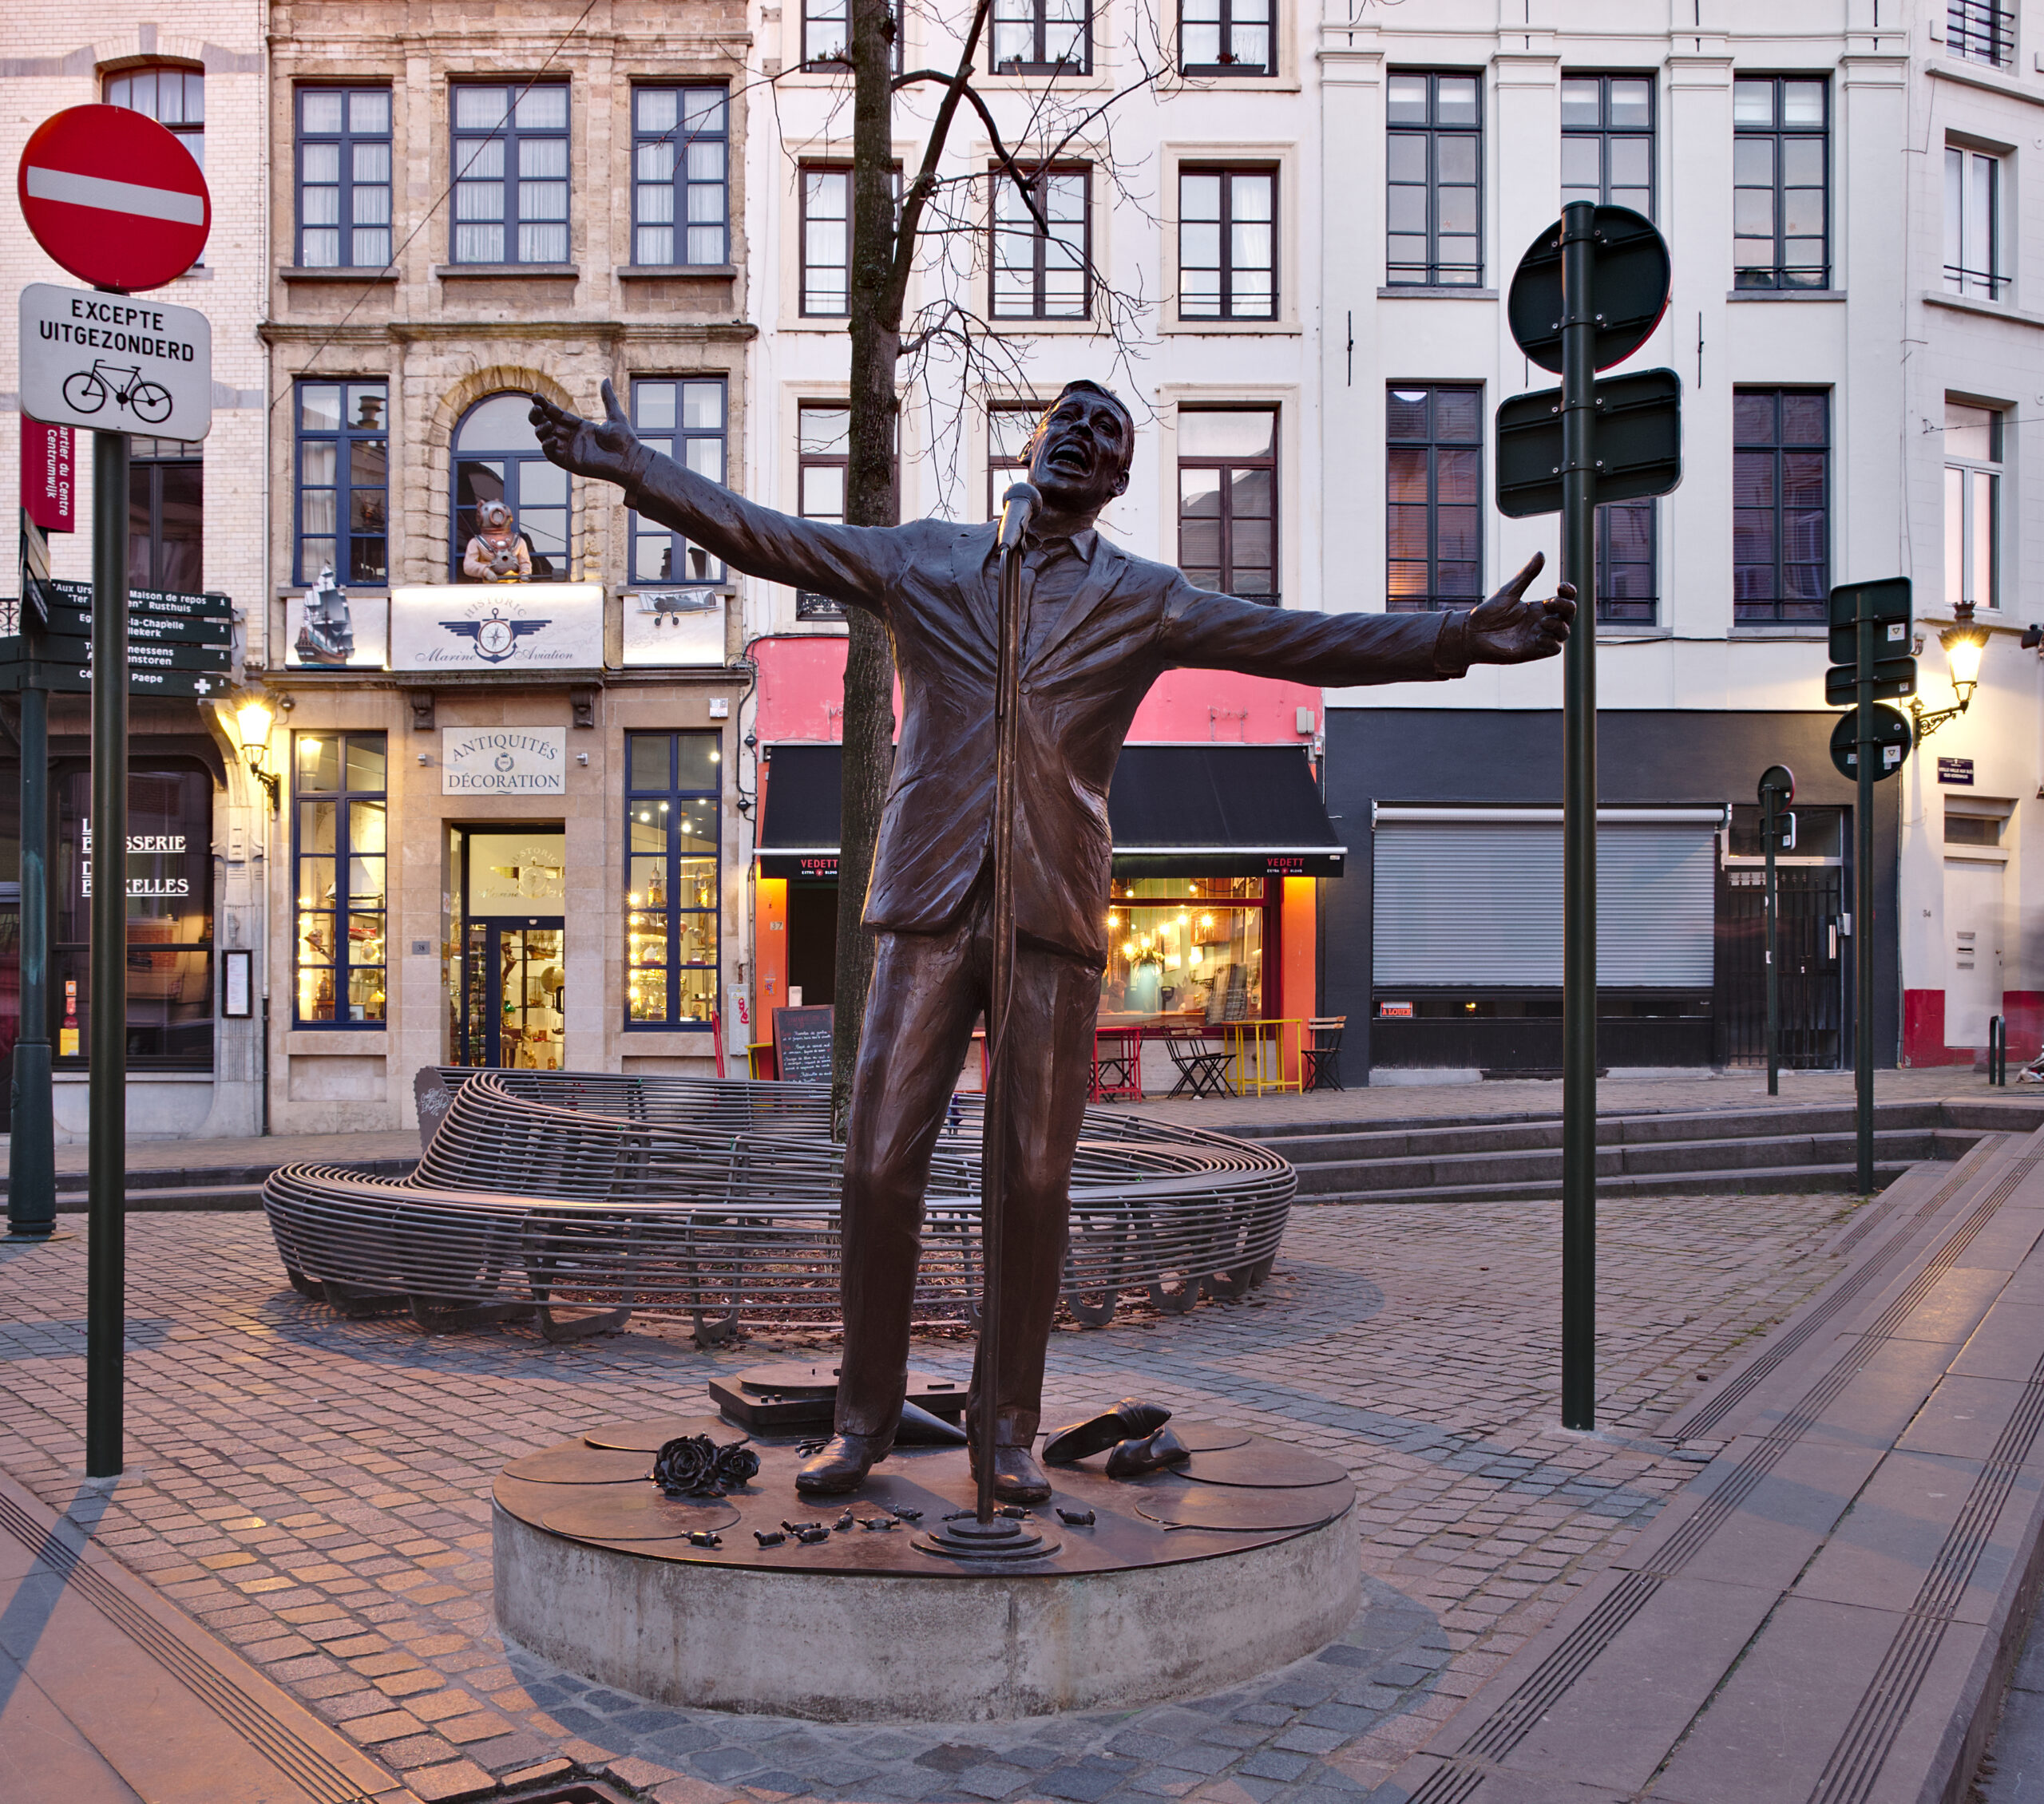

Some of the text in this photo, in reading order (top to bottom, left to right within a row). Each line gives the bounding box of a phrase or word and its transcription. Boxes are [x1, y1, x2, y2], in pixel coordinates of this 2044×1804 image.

[72, 299, 164, 331] EXCEPTE
[39, 320, 194, 362] UITGEZONDERD
[46, 429, 57, 499] Centrumwijk
[58, 425, 70, 516] artier du Centre
[129, 590, 162, 601] Maison
[180, 595, 207, 605] repos
[149, 601, 192, 613] Rusthuis
[464, 596, 527, 619] HISTORIC
[127, 617, 184, 630] -la-Chapelle
[128, 645, 174, 657] neessens
[414, 646, 573, 662] Marine Aviation
[132, 673, 164, 684] Paepe
[452, 734, 558, 762] ANTIQUITÉS
[449, 772, 561, 788] DÉCORATION
[800, 858, 838, 868] VEDETT
[1266, 857, 1305, 867] VEDETT
